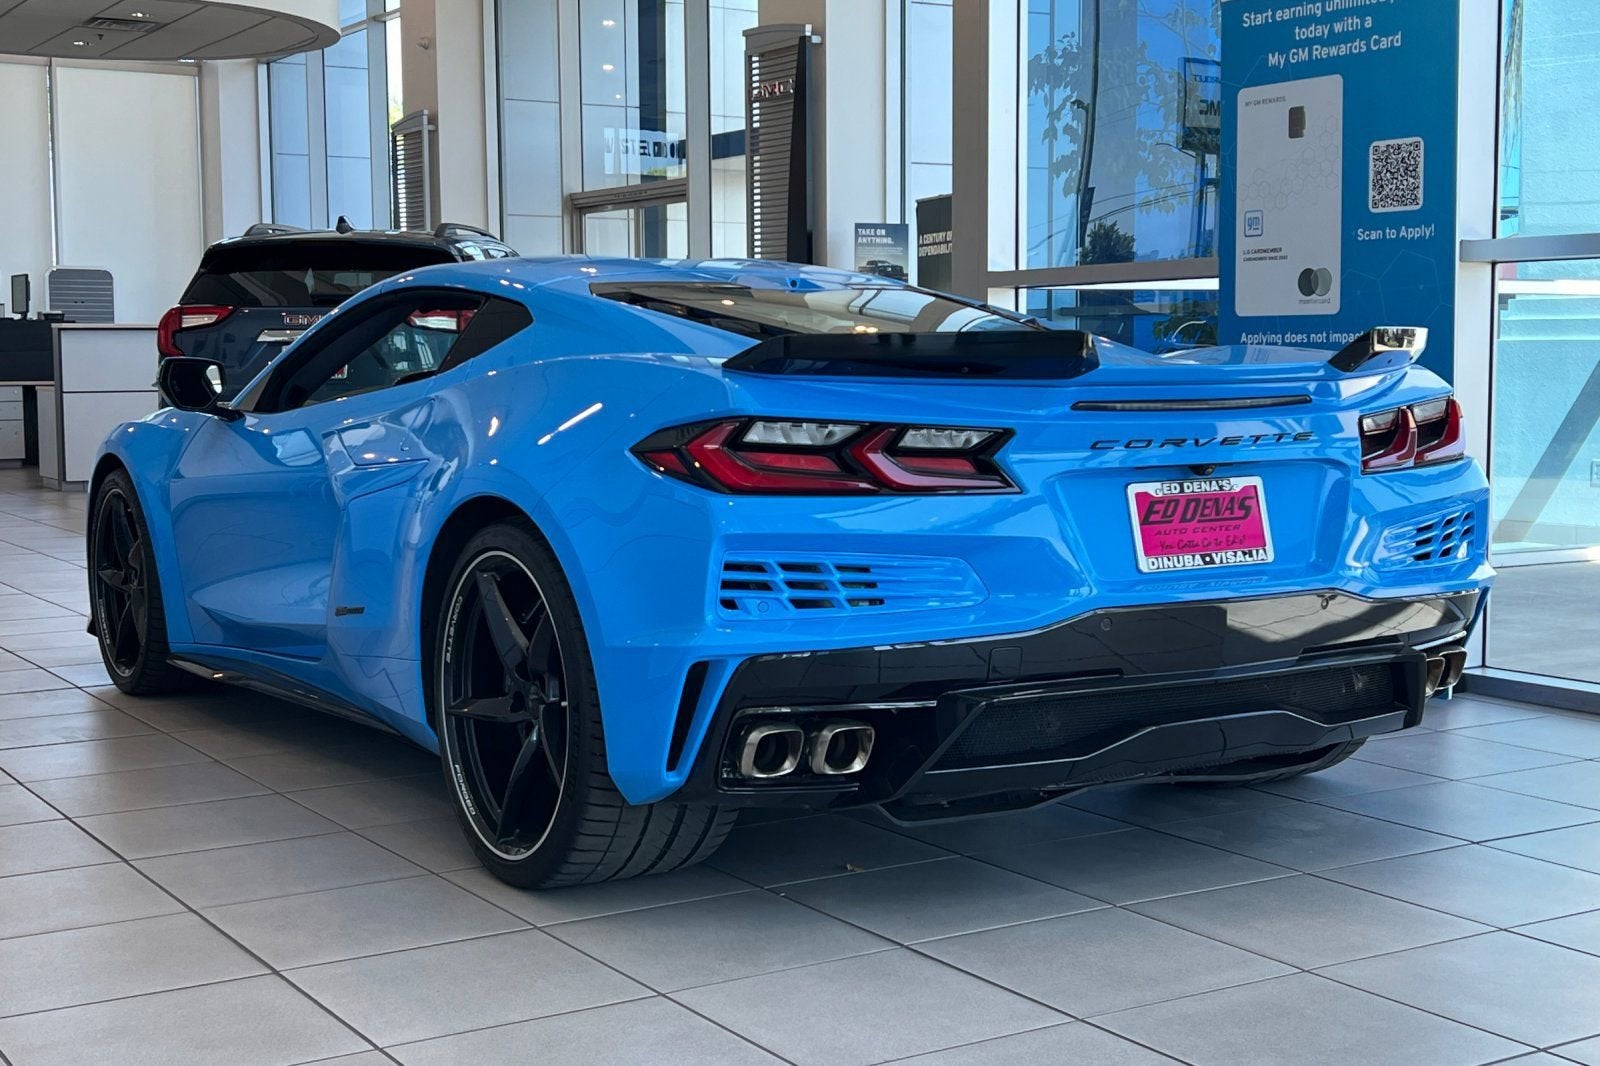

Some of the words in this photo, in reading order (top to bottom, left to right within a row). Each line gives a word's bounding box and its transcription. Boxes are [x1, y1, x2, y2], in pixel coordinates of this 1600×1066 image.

[1242, 9, 1272, 28] Start
[1275, 1, 1322, 21] earning
[1326, 0, 1386, 12] unlim
[1295, 23, 1330, 41] today
[1333, 16, 1361, 34] with
[1364, 16, 1372, 29] a
[1268, 52, 1286, 69] My
[1289, 47, 1309, 64] GM
[1313, 38, 1367, 60] Rewards
[1370, 31, 1402, 51] Card
[857, 228, 875, 236] TAKE
[876, 228, 886, 236] ON
[1247, 216, 1260, 231] gm
[857, 236, 894, 245] ANYTHING.
[919, 234, 923, 245] A
[923, 231, 946, 244] CENTURY
[1357, 227, 1383, 241] Scan
[1385, 227, 1397, 240] to
[1399, 224, 1435, 242] Apply!
[918, 242, 952, 257] DEPENDABILIT
[1251, 246, 1283, 255] CARDMEMBER
[1240, 331, 1283, 346] Applying
[1284, 331, 1308, 344] does
[1310, 331, 1327, 343] not
[1330, 330, 1364, 345] impac
[1090, 430, 1314, 450] CORVETTE
[1163, 482, 1180, 494] ED
[1183, 479, 1232, 493] DENA'S
[1141, 497, 1180, 525] ED
[1179, 495, 1255, 523] DENA'S
[1155, 527, 1188, 536] AUTO
[1193, 523, 1241, 534] CENTER
[1148, 556, 1205, 570] DINUBA
[1212, 548, 1268, 564] VISALIA
[445, 595, 464, 664] CORVETTE
[453, 763, 477, 817] FORGED
